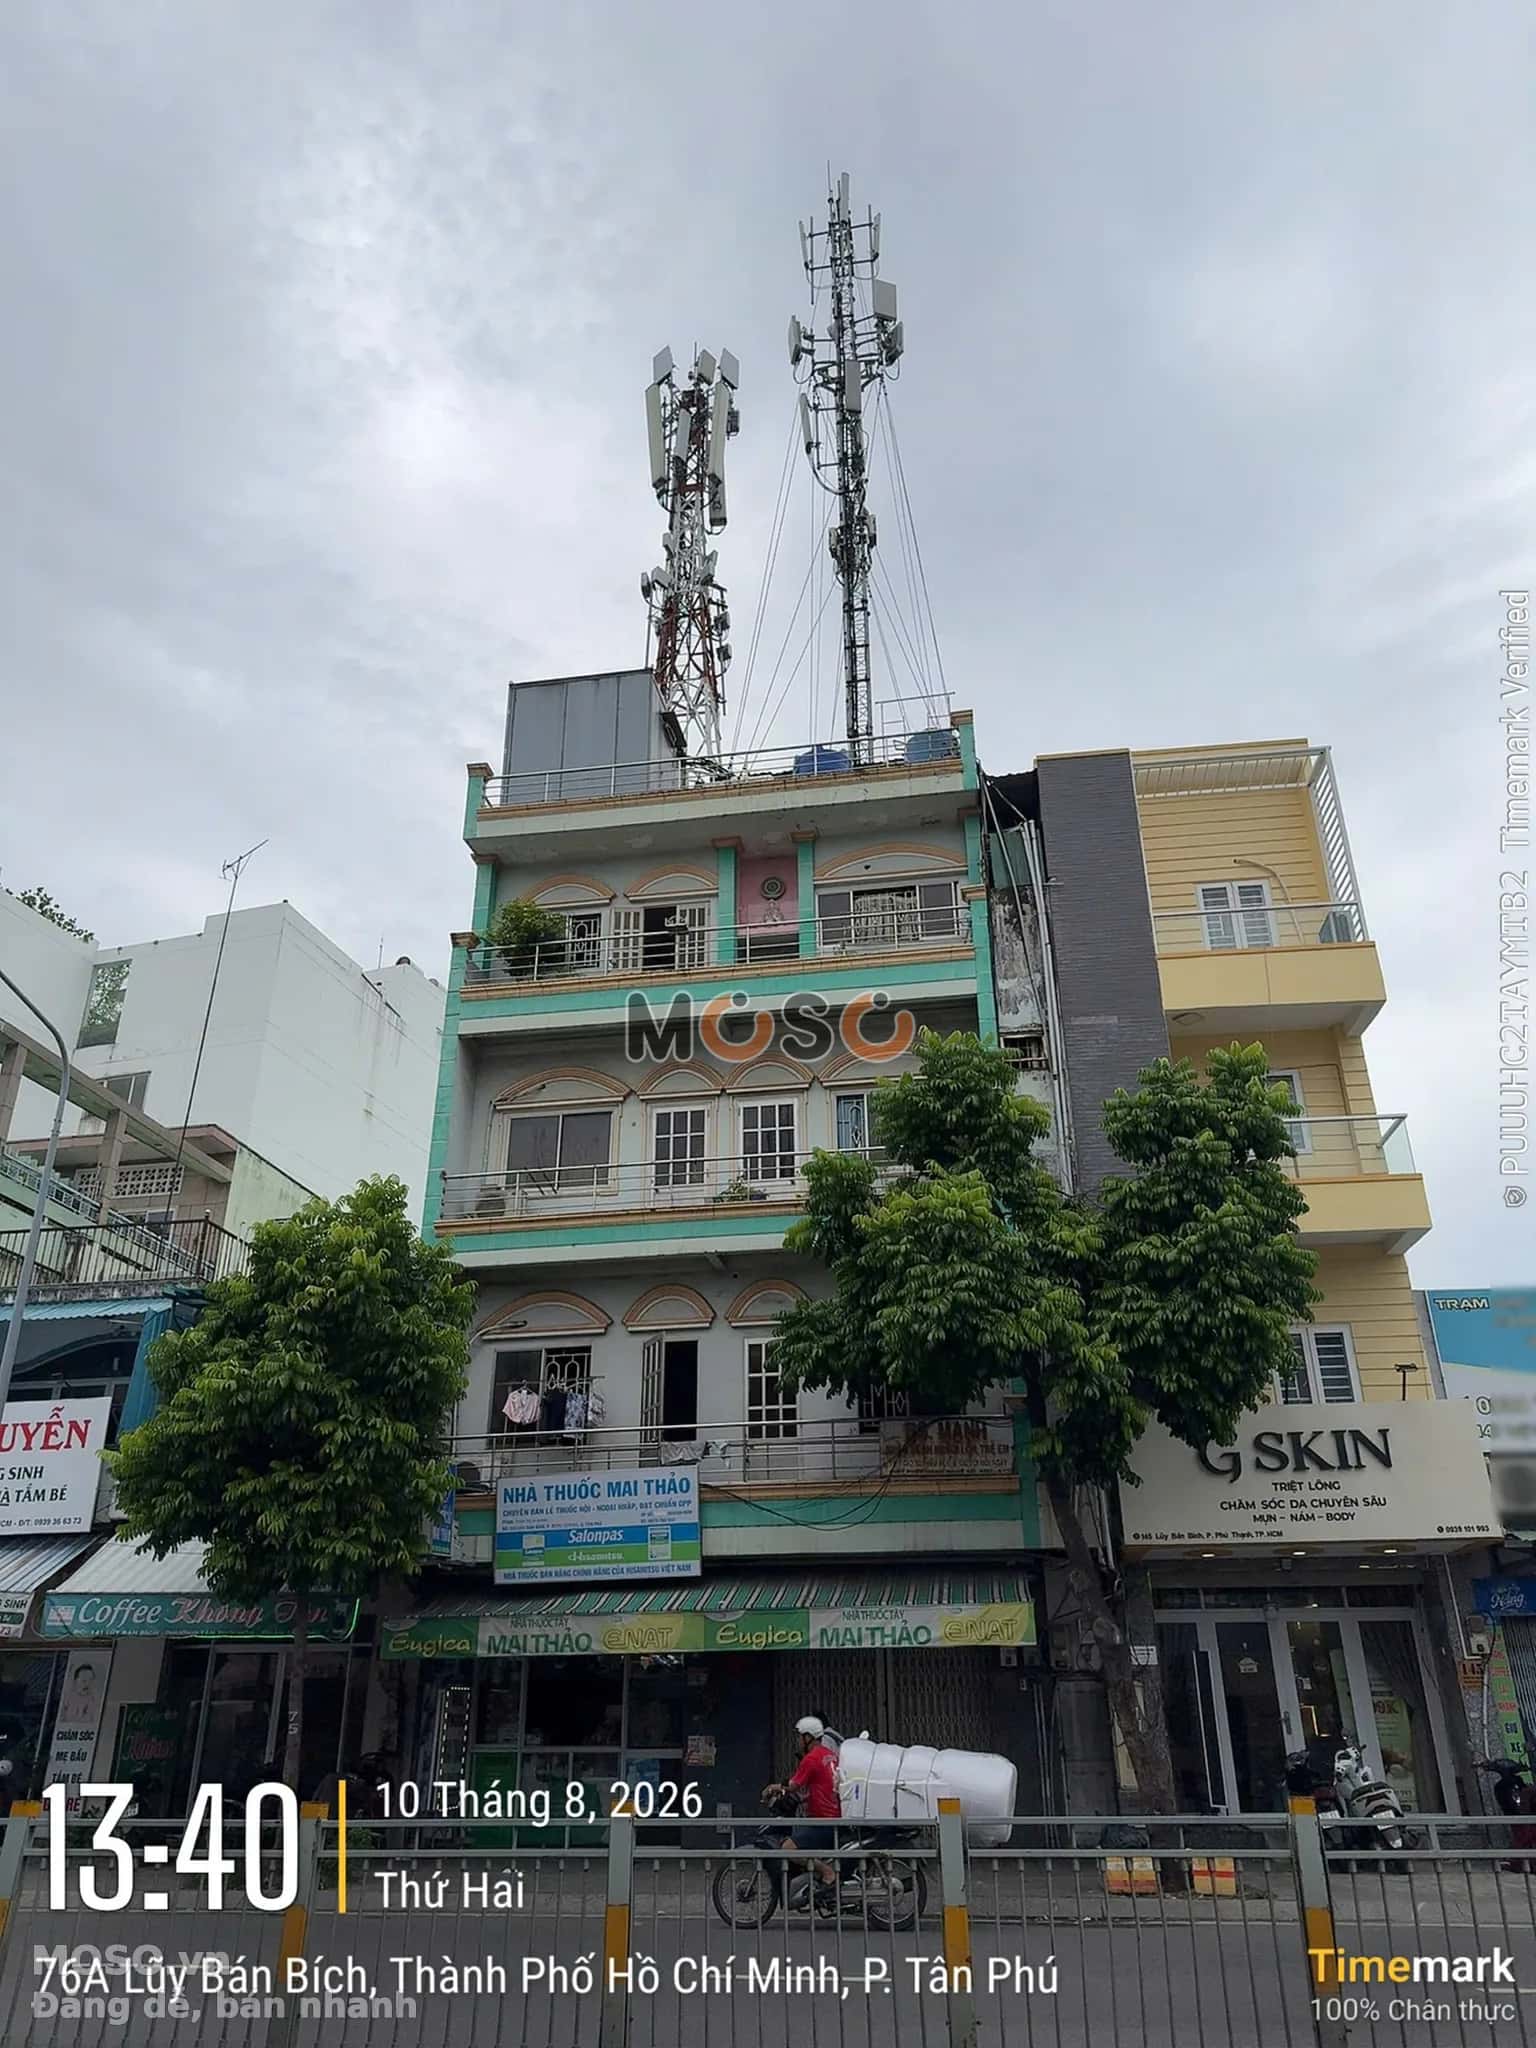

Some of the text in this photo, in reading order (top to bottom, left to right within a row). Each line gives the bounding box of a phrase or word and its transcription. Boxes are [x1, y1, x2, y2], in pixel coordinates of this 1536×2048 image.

[1434, 1298, 1490, 1312] TRẠM
[1253, 1429, 1393, 1473] SKIN
[8, 1466, 44, 1480] SINH
[50, 1484, 67, 1501] BÉ
[502, 1471, 690, 1504] NHÀ THUỐC MAI THẢO
[1272, 1478, 1341, 1493] TRIỆT LÔNG
[1220, 1495, 1387, 1511] CHĂM SÓC DA CHUYÊN SÂU
[1253, 1513, 1277, 1525] MỤN
[1290, 1511, 1316, 1522] NÁM
[1326, 1511, 1355, 1522] BODY
[567, 1528, 624, 1545] Salonpas
[4, 1599, 28, 1609] SINH
[79, 1597, 162, 1629] Coffee
[387, 1632, 471, 1657] Eugica
[716, 1623, 803, 1649] Eugica
